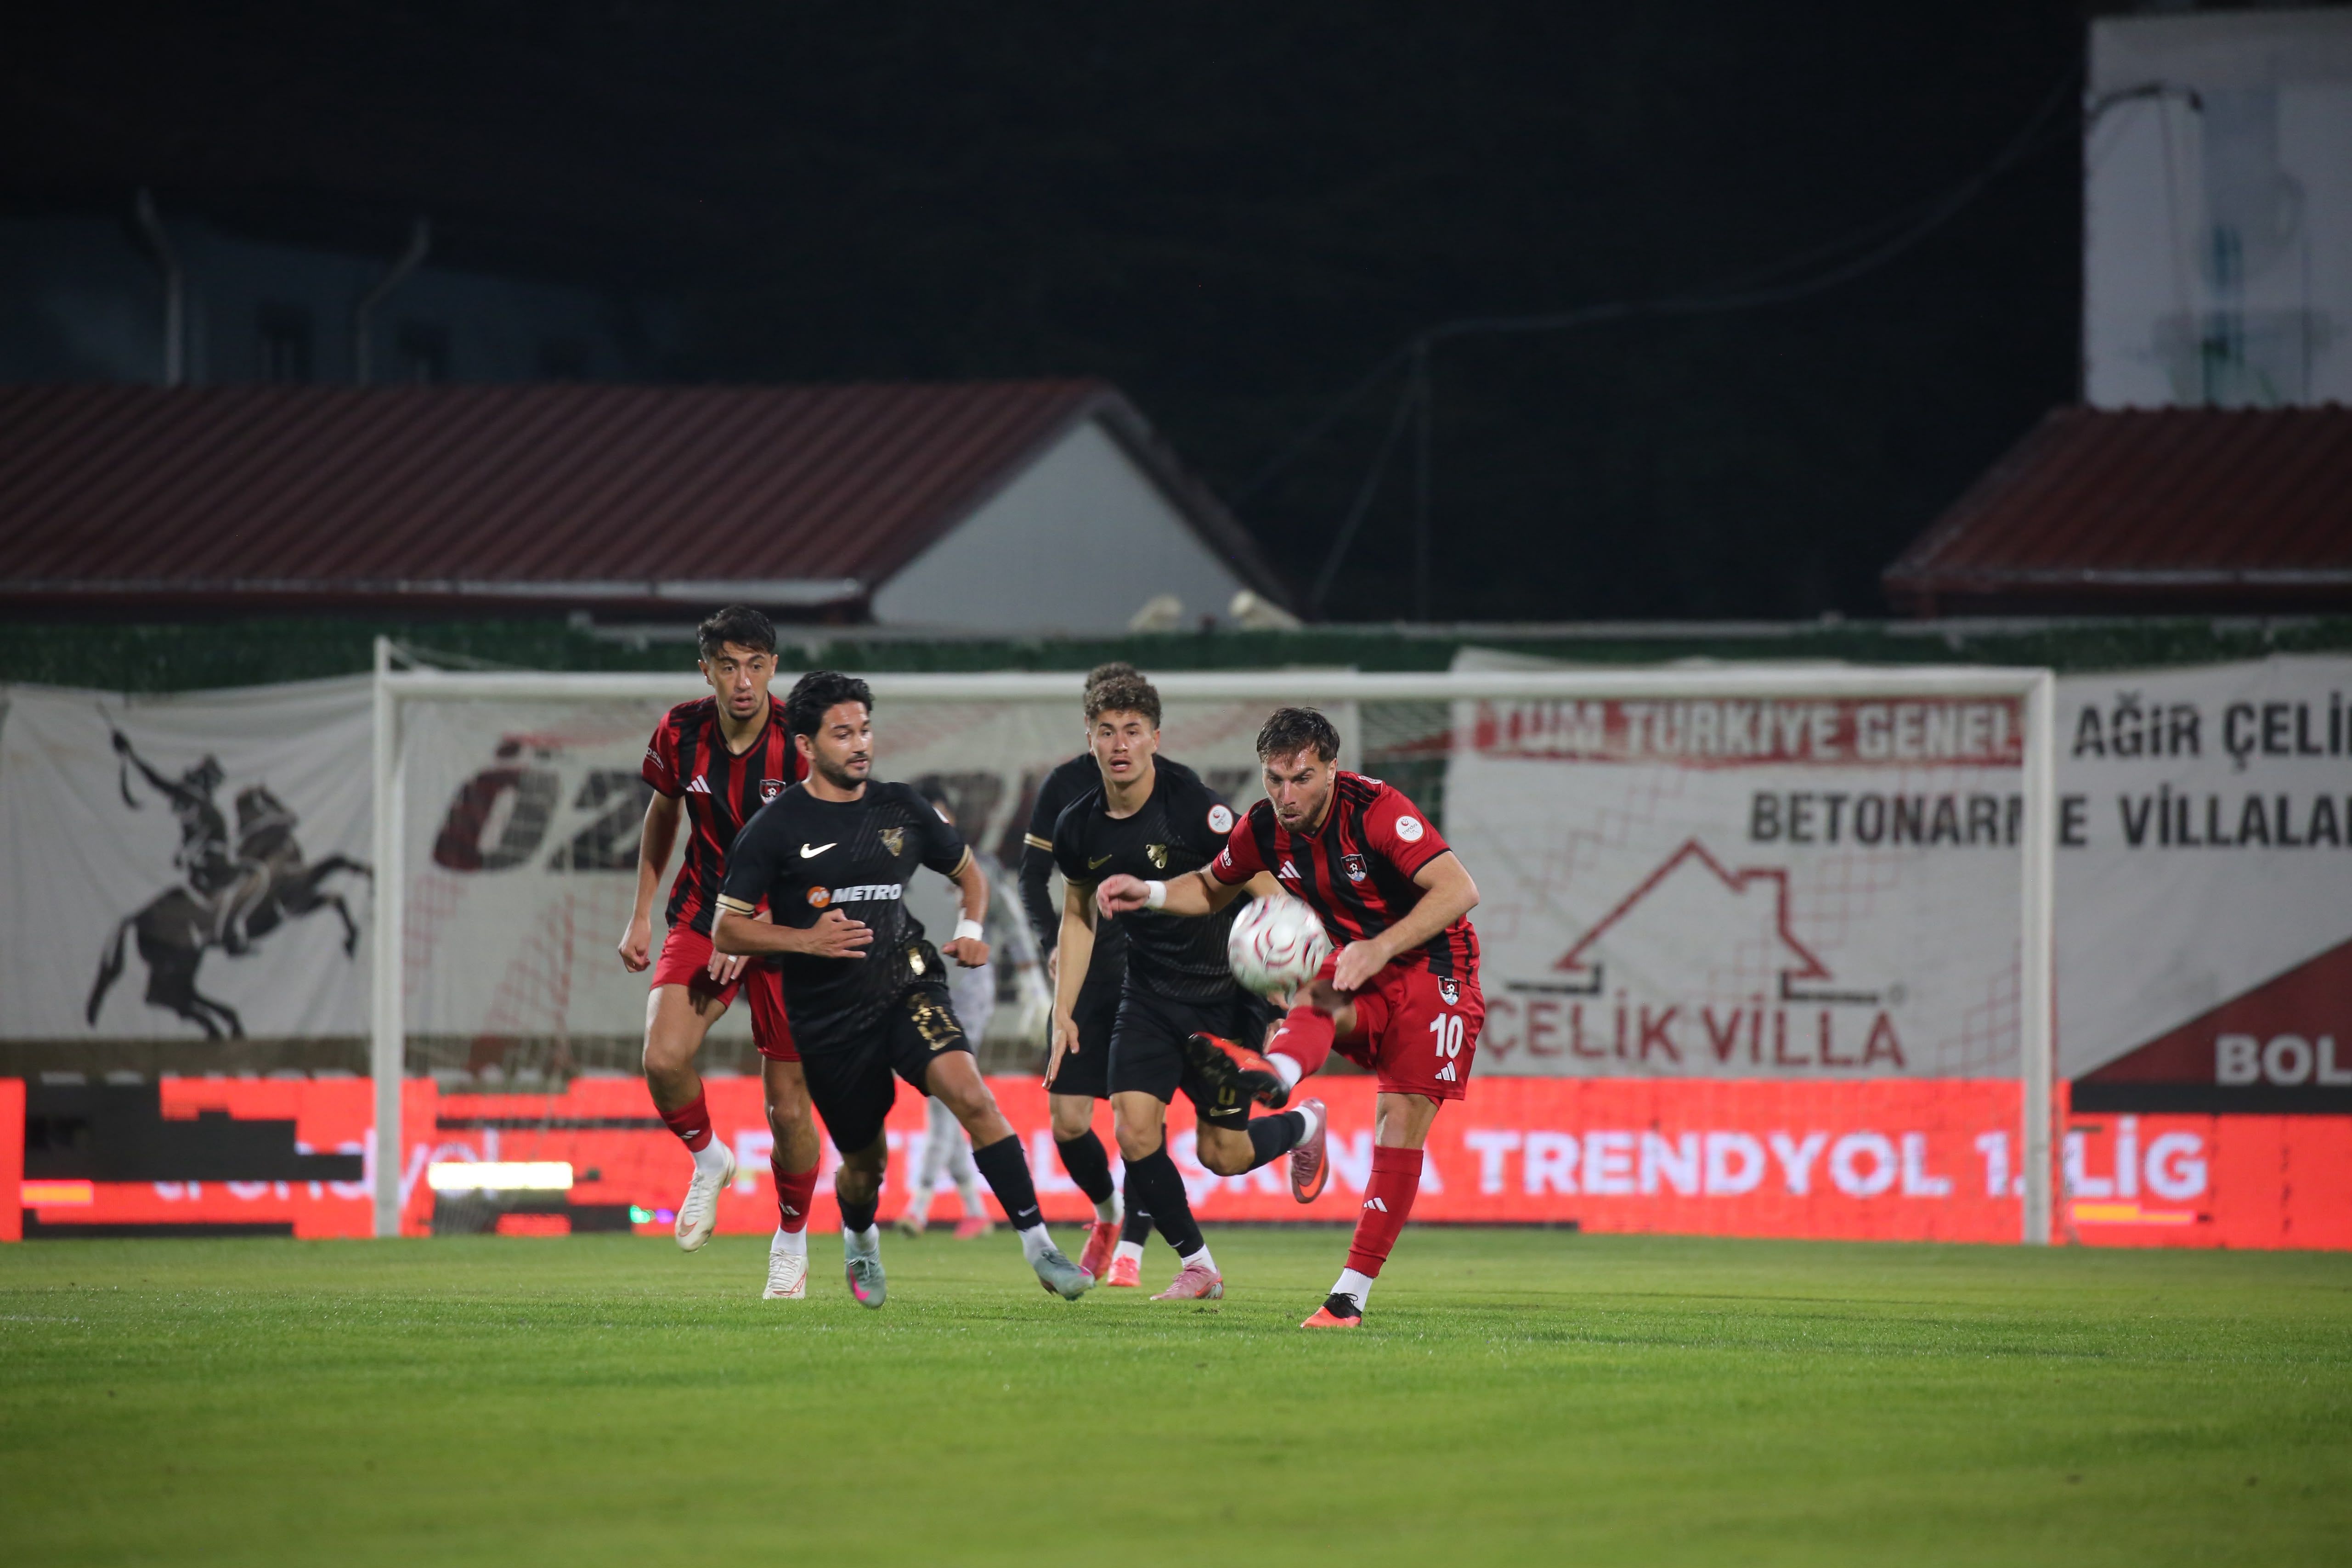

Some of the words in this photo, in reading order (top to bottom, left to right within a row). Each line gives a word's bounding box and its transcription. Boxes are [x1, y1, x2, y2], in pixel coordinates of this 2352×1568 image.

[2223, 690, 2352, 773] ÇELİ
[2120, 782, 2352, 846] VİLLALA
[830, 884, 902, 903] METRO
[1430, 1013, 1464, 1059] 10
[1481, 991, 1681, 1062] ÇELİK
[1702, 993, 1907, 1068] VİLLA
[1465, 1130, 1953, 1197] TRENDYOL
[2064, 1116, 2206, 1201] LİG
